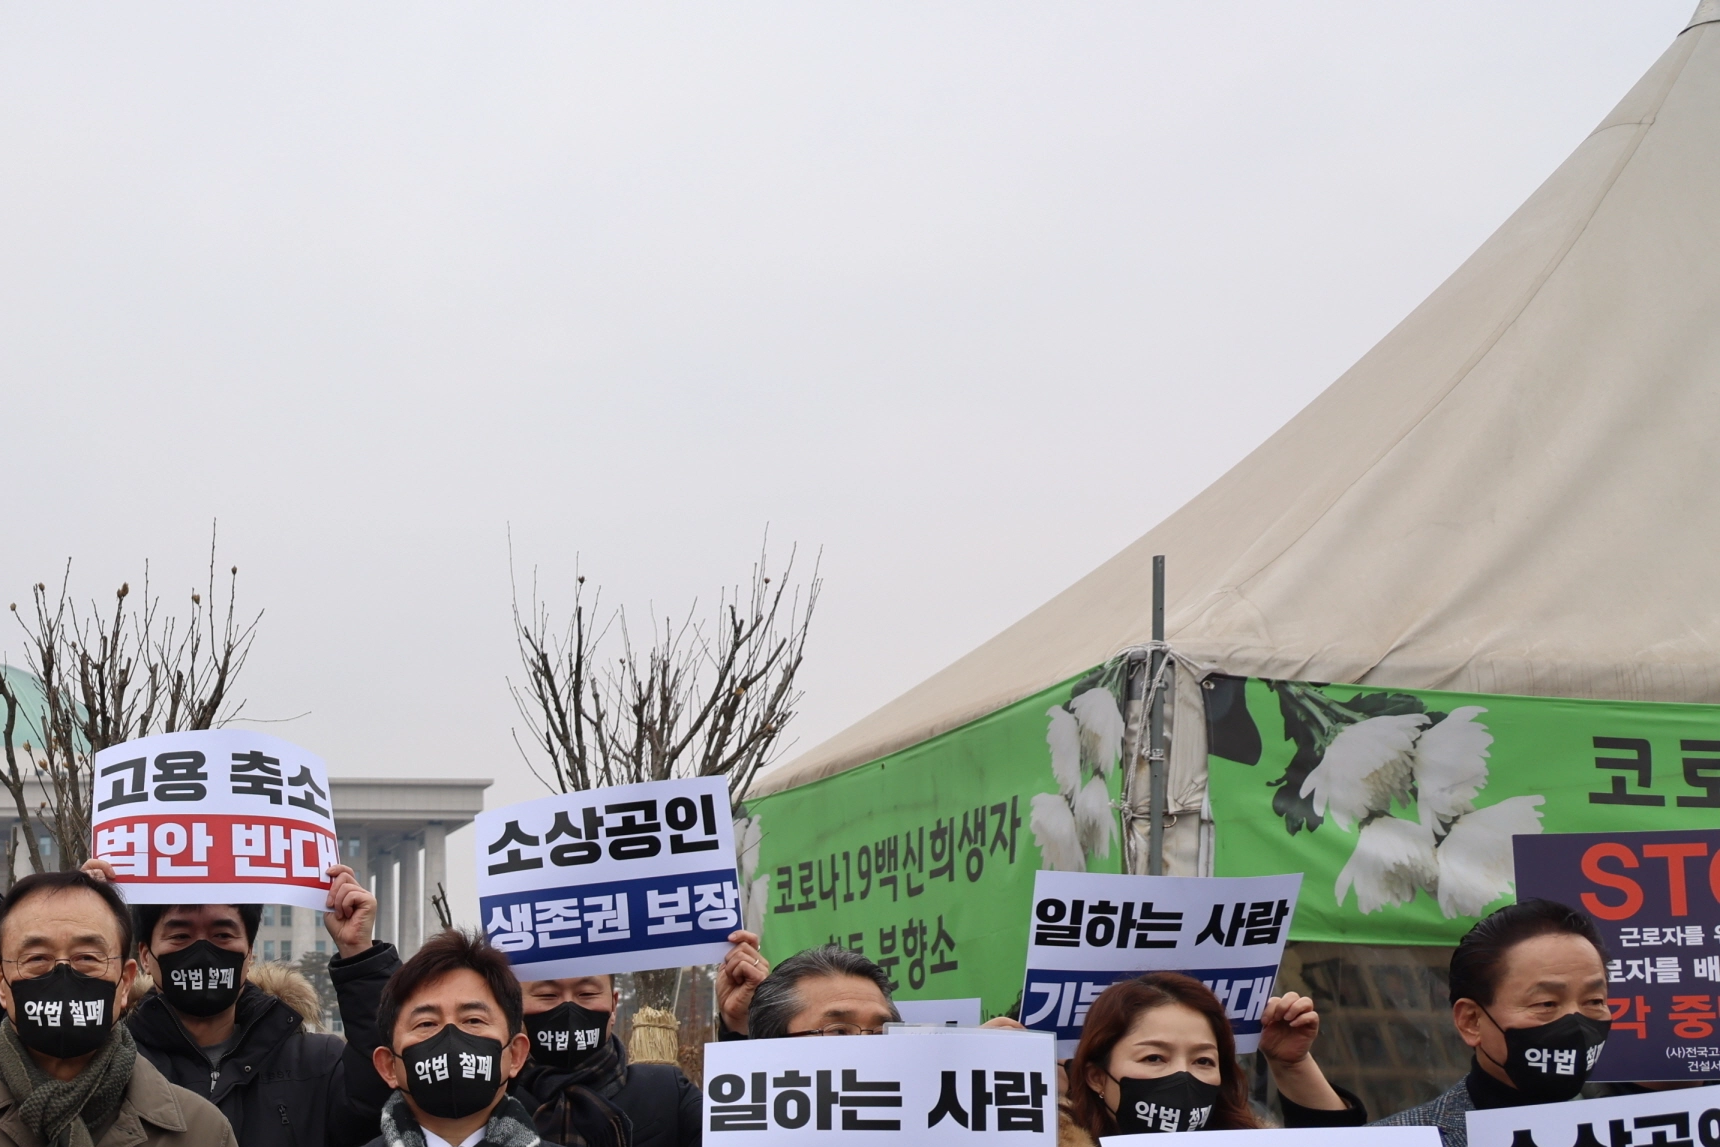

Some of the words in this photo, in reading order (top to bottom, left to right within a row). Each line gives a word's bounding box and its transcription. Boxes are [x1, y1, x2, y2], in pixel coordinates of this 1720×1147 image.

[97, 750, 208, 813] 고용
[230, 750, 331, 820] 축소
[96, 822, 214, 877] 법안
[231, 823, 340, 883] 반대
[487, 793, 720, 876] 소상공인
[774, 794, 1022, 914] 코로나19백신희생자
[1580, 842, 1720, 921] ST
[486, 892, 631, 953] 생존권
[646, 881, 739, 936] 보장
[1034, 898, 1183, 949] 일하는
[1194, 899, 1290, 947] 사람
[1619, 925, 1705, 947] 근로자를
[877, 914, 958, 991] 분향소
[170, 968, 203, 991] 악법
[208, 966, 235, 989] 철폐
[24, 1000, 62, 1027] 악법
[69, 999, 105, 1026] 철폐
[1668, 995, 1720, 1039] 중
[537, 1030, 569, 1051] 악법
[574, 1028, 600, 1050] 철폐
[1525, 1048, 1577, 1075] 악법
[1665, 1046, 1720, 1059] (사)전국고
[415, 1053, 450, 1084] 악법
[459, 1052, 493, 1081] 철폐
[708, 1069, 902, 1132] 일하는
[928, 1069, 1048, 1133] 사람
[1135, 1101, 1181, 1132] 악법
